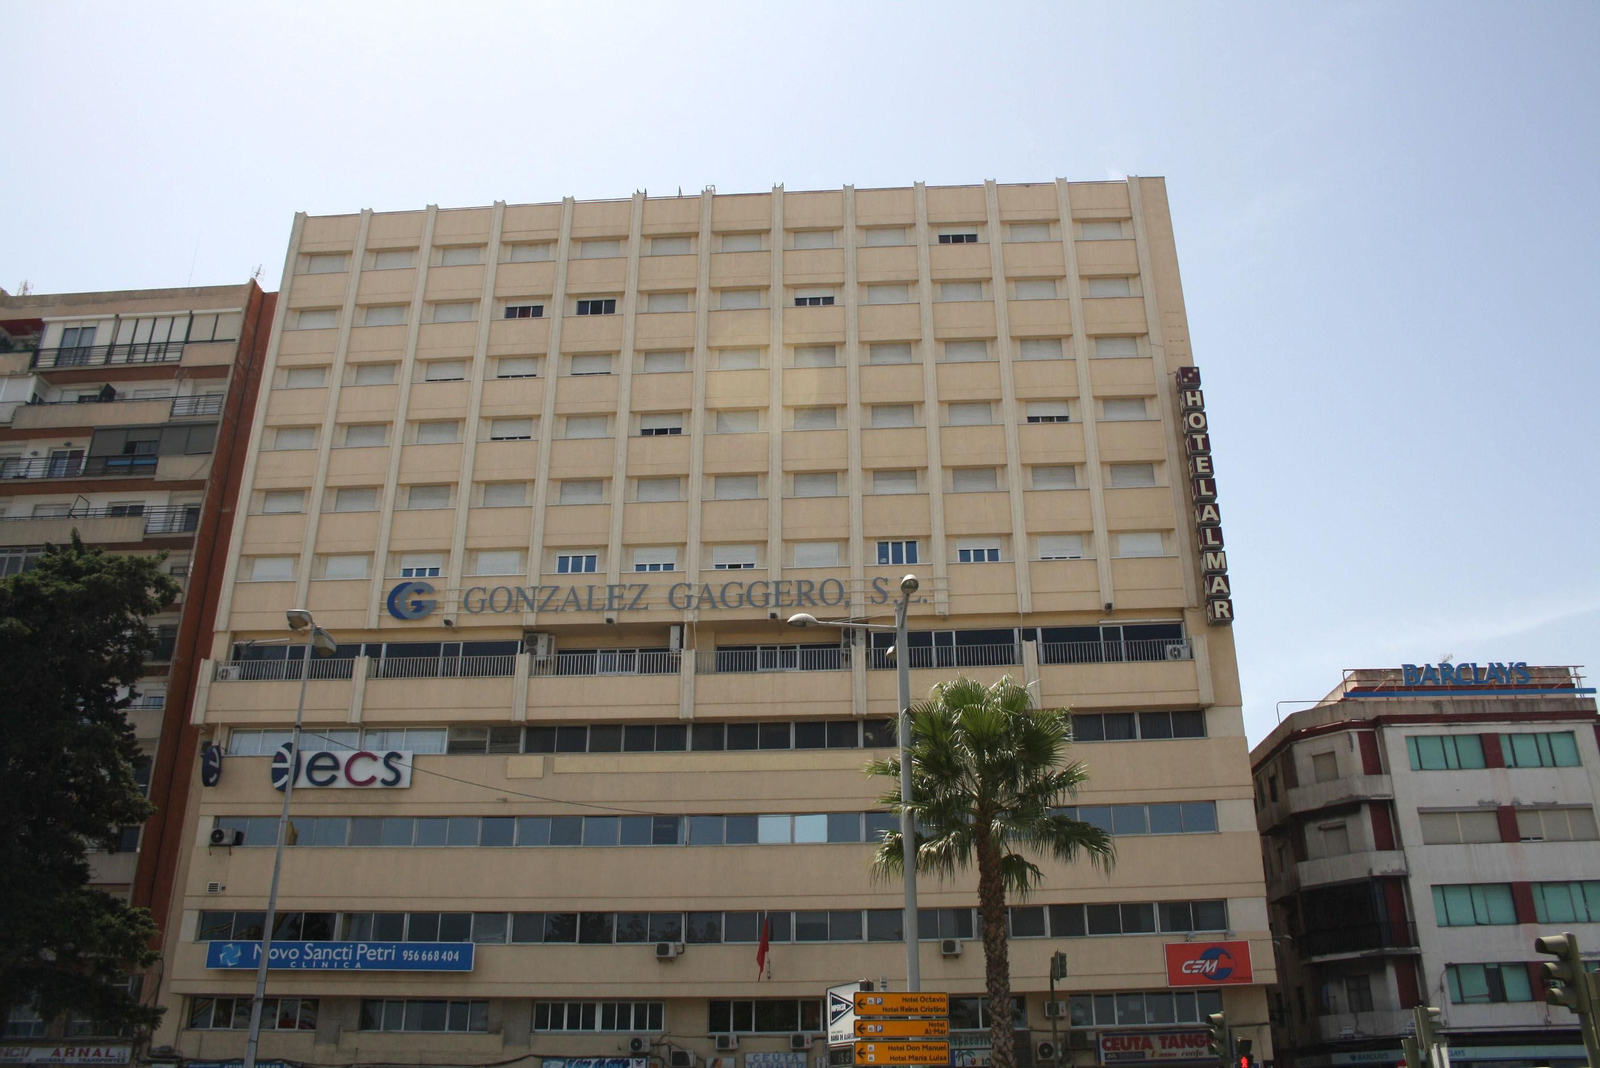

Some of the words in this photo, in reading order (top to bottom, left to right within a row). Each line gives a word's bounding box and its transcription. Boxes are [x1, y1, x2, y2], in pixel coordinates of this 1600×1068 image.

[1185, 390, 1214, 496] HOTEL
[1201, 504, 1231, 619] ALMAR
[463, 583, 649, 614] GONZALEZ
[667, 578, 851, 610] GAGGERO,
[870, 576, 928, 605] S..
[1400, 661, 1530, 687] BARCLAYS
[252, 943, 300, 960] Novo
[303, 943, 353, 960] Sancti
[356, 943, 396, 961] Petri
[402, 949, 419, 962] 956
[421, 949, 439, 962] 668
[441, 950, 459, 962] 404
[1181, 959, 1218, 974] CEM
[906, 1044, 920, 1052] Don
[922, 1044, 947, 1052] Manuel
[1101, 1036, 1154, 1051] CEUTA
[1158, 1033, 1210, 1049] TANG
[51, 1046, 116, 1057] ARNAL
[752, 1053, 800, 1063] CEUTA
